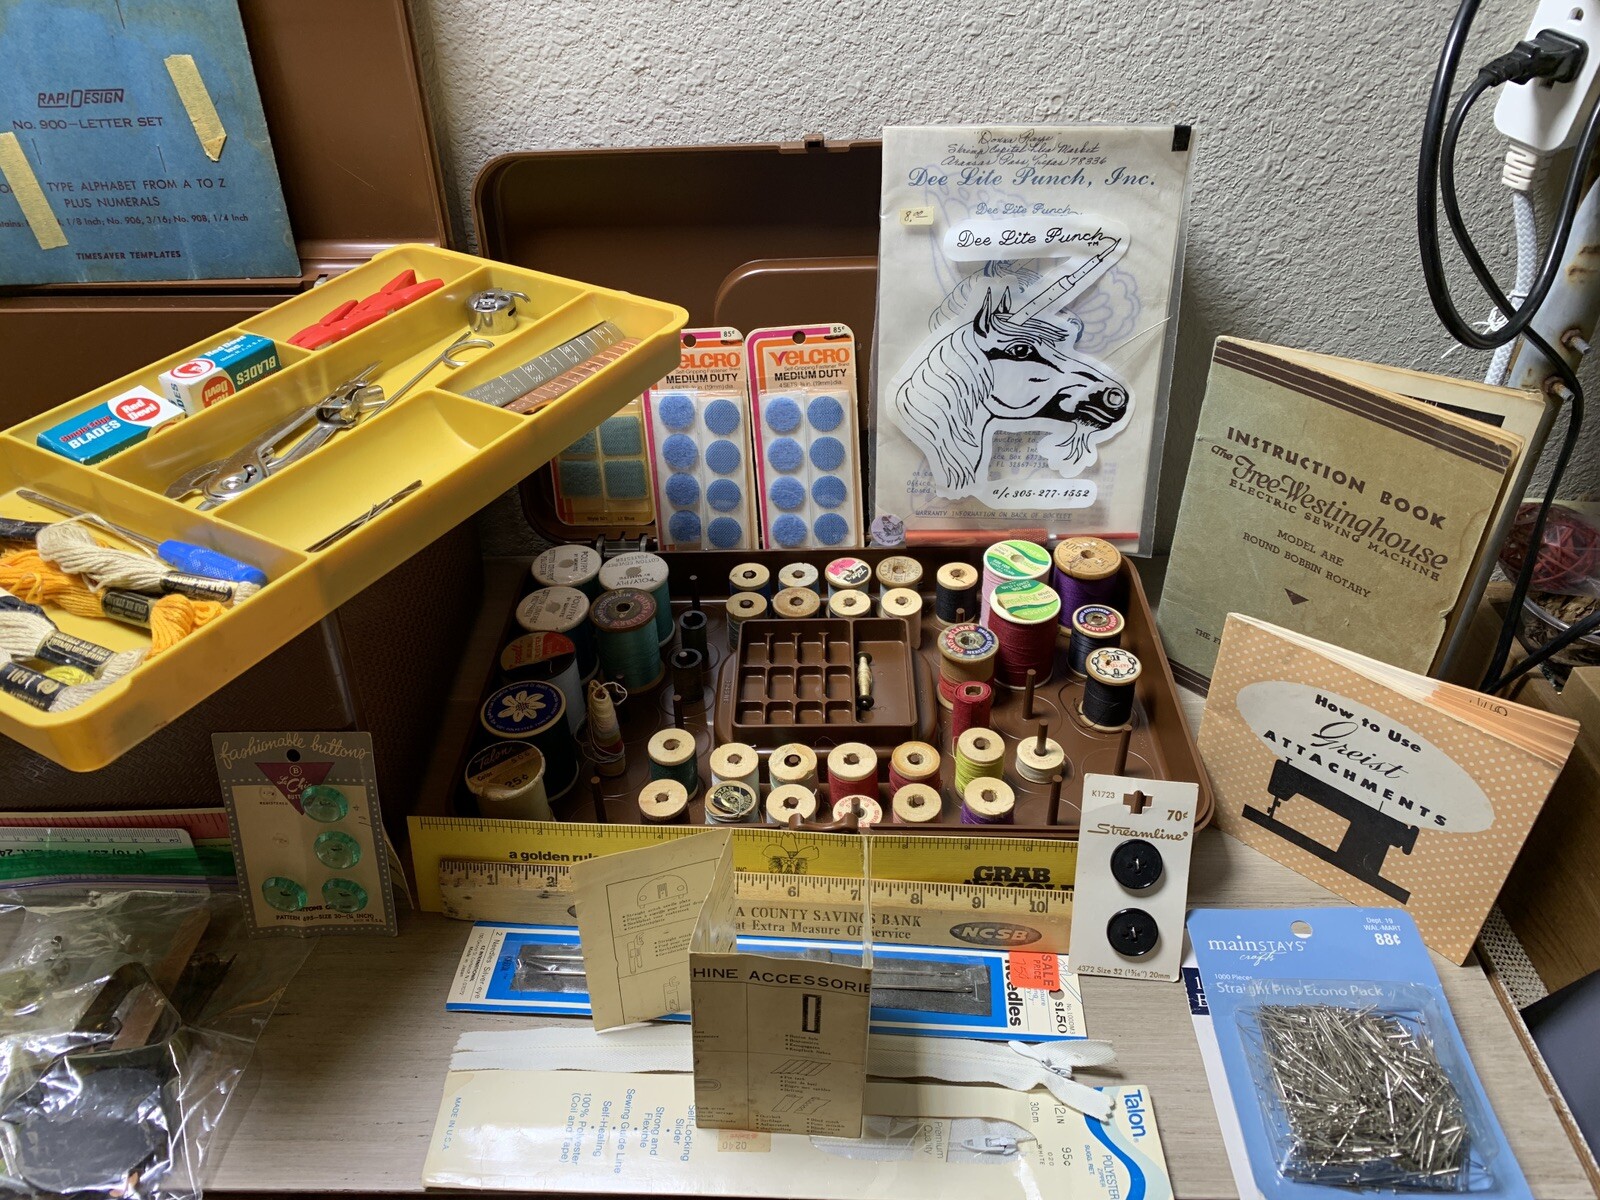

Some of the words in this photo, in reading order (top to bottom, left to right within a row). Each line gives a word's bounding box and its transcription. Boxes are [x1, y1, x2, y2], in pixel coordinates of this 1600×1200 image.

[38, 89, 124, 108] RAPIDESIGN
[13, 120, 36, 130] No.
[138, 117, 163, 127] SET
[1058, 142, 1101, 154] Market
[47, 182, 73, 192] TYPE
[81, 180, 137, 192] ALPHABET
[143, 179, 177, 189] FROM
[183, 179, 192, 188] A
[197, 178, 213, 188] TO
[218, 178, 226, 188] Z
[908, 167, 948, 187] Dee
[957, 167, 1002, 186] Lite
[1012, 167, 1092, 187] Punch,
[1104, 167, 1155, 187] Inc.
[65, 198, 91, 208] PLUS
[97, 197, 160, 207] NUMERALS
[976, 202, 998, 215] Dee
[1002, 204, 1027, 215] Lite
[66, 218, 82, 226] 1/8
[107, 217, 122, 225] No.
[214, 215, 229, 223] 1/4
[231, 214, 248, 222] Inch
[957, 230, 991, 248] Dee
[999, 230, 1036, 246] Lite
[1045, 227, 1107, 246] Punch
[76, 252, 125, 261] TIMESAVER
[130, 251, 181, 259] TEMPLATES
[236, 356, 276, 385] BLADES
[681, 352, 740, 368] ELCRO
[666, 374, 708, 384] MEDIUM
[710, 373, 738, 382] DUTY
[774, 372, 817, 381] MEDIUM
[818, 369, 846, 379] DUTY
[121, 399, 146, 414] Red
[128, 403, 158, 420] Devil
[68, 420, 121, 449] BLADES
[1227, 426, 1366, 494] INSTRUCTION
[1380, 490, 1447, 530] BOOK
[1211, 445, 1234, 461] The
[1232, 455, 1449, 570] Free-Westinghouse
[1229, 478, 1297, 514] ELECTRIC
[1304, 512, 1362, 544] SEWING
[1368, 541, 1440, 581] MACHINE
[1277, 530, 1317, 556] MODEL
[1321, 549, 1344, 567] ARE
[1243, 532, 1280, 556] ROUND
[1284, 550, 1322, 575] BOBBIN
[1325, 570, 1371, 598] ROTARY
[1194, 628, 1211, 641] THE
[1314, 694, 1355, 720] How
[1361, 718, 1380, 734] to
[1387, 729, 1421, 753] Use
[219, 733, 306, 769] fashionable
[310, 735, 370, 759] buttons
[474, 746, 512, 770] Talon
[1310, 721, 1410, 780] Greist
[504, 774, 529, 788] 25¢
[1264, 729, 1448, 827] ATTACHMENTS
[1092, 790, 1115, 799] K1723
[1167, 810, 1188, 821] 70¢
[1087, 823, 1184, 841] Streamline
[508, 851, 518, 860] a
[520, 850, 571, 862] golden
[486, 875, 494, 885] 1
[546, 876, 556, 887] 2
[973, 865, 1051, 882] GRAB
[788, 885, 797, 898] 6
[850, 888, 860, 901] 7
[909, 892, 920, 906] 8
[971, 896, 982, 909] 9
[1029, 900, 1047, 914] 10
[751, 907, 809, 921] COUNTY
[813, 910, 876, 926] SAVINGS
[882, 914, 922, 928] BANK
[751, 920, 785, 932] Extra
[790, 922, 841, 936] Measure
[1363, 924, 1401, 932] WAL-MART
[1366, 917, 1382, 925] Dept.
[960, 926, 1029, 942] NCSB
[1374, 933, 1401, 947] 88¢
[1239, 951, 1275, 966] crafts
[1033, 959, 1041, 980] PRICE
[1042, 954, 1054, 987] SALE
[1077, 965, 1095, 973] 4372
[1097, 966, 1111, 974] Size
[1114, 968, 1123, 976] 32
[1149, 971, 1170, 979] 20mm
[1274, 984, 1301, 997] Pins
[1304, 985, 1348, 997] Econo
[1350, 985, 1383, 997] Pack
[1054, 1001, 1068, 1034] $1.50
[453, 1096, 462, 1118] MADE
[569, 1092, 581, 1113] (Coil
[582, 1093, 592, 1118] 100%
[624, 1088, 636, 1120] Sewing
[1029, 1101, 1039, 1123] 30cm
[448, 1119, 457, 1129] IN
[654, 1106, 665, 1136] Strong
[1123, 1089, 1147, 1138] Talon
[592, 1100, 612, 1158] Self-Healing
[619, 1121, 630, 1150] Guide
[639, 1112, 653, 1149] Flexible
[673, 1118, 685, 1145] Slider
[680, 1105, 696, 1161] Self-Locking
[571, 1119, 587, 1165] Polyester
[650, 1137, 659, 1156] and
[935, 1121, 944, 1159] Premium
[613, 1152, 623, 1174] Line
[1037, 1144, 1045, 1165] WHITE
[1084, 1144, 1092, 1161] SUGG.
[1097, 1168, 1106, 1187] ZIPPER
[1101, 1155, 1119, 1200] POLYESTER
